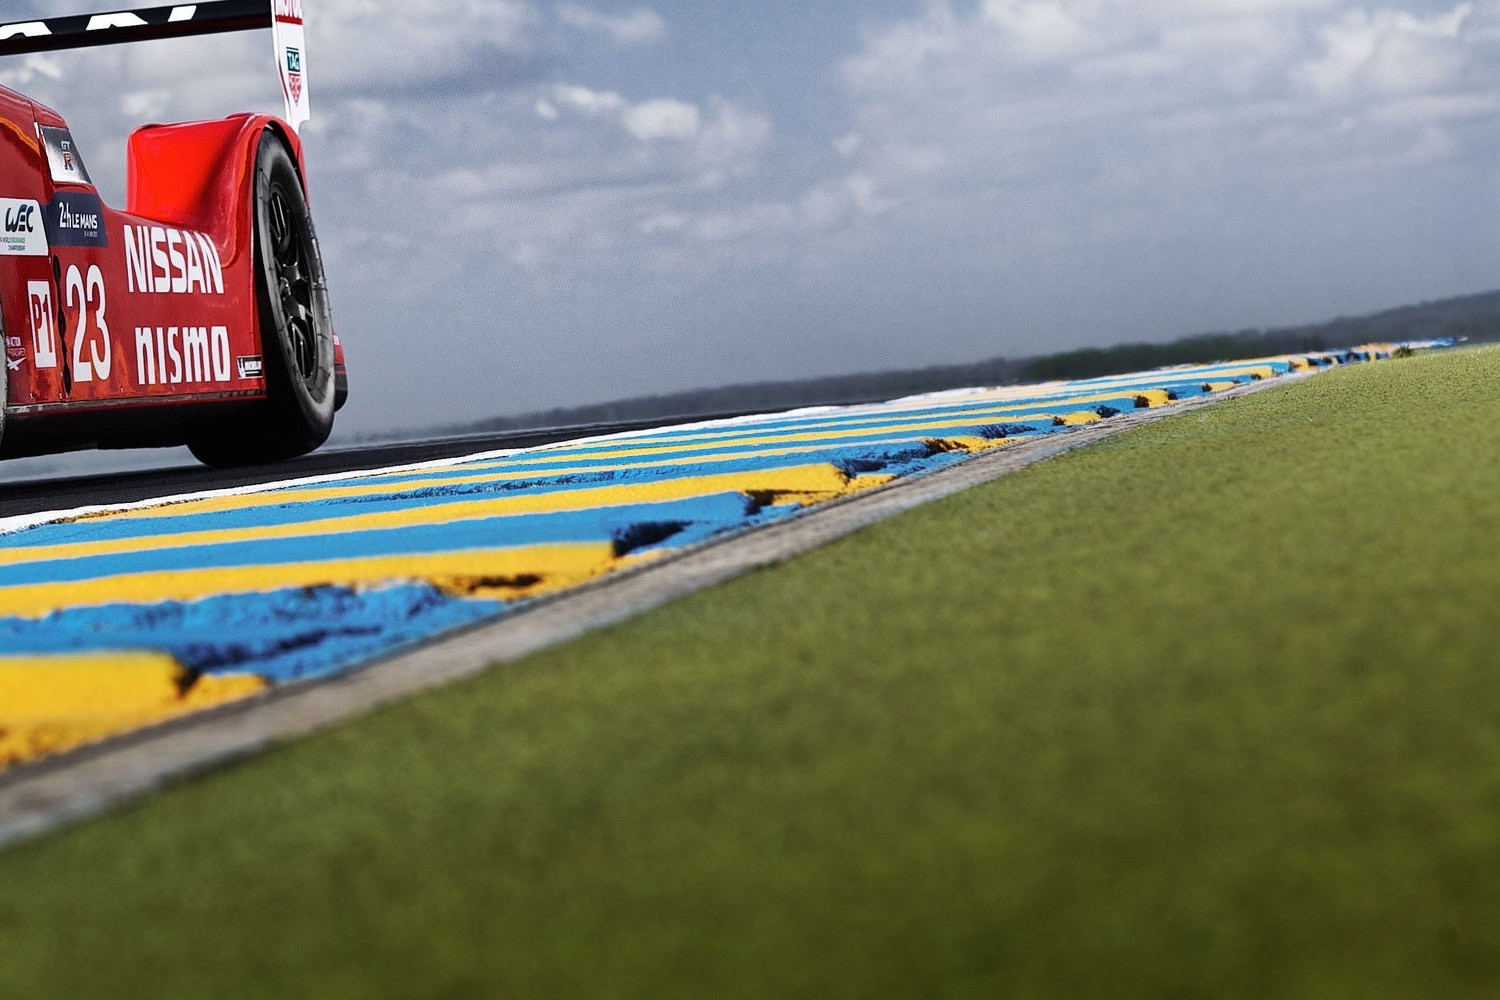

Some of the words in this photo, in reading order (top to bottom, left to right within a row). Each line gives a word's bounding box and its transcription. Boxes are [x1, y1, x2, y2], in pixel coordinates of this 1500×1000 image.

[62, 151, 74, 171] R
[5, 204, 34, 233] WEC
[72, 213, 80, 229] LE
[80, 214, 98, 230] MANS
[123, 224, 225, 294] NISSAN
[66, 264, 111, 382] 23
[134, 325, 231, 385] nismo
